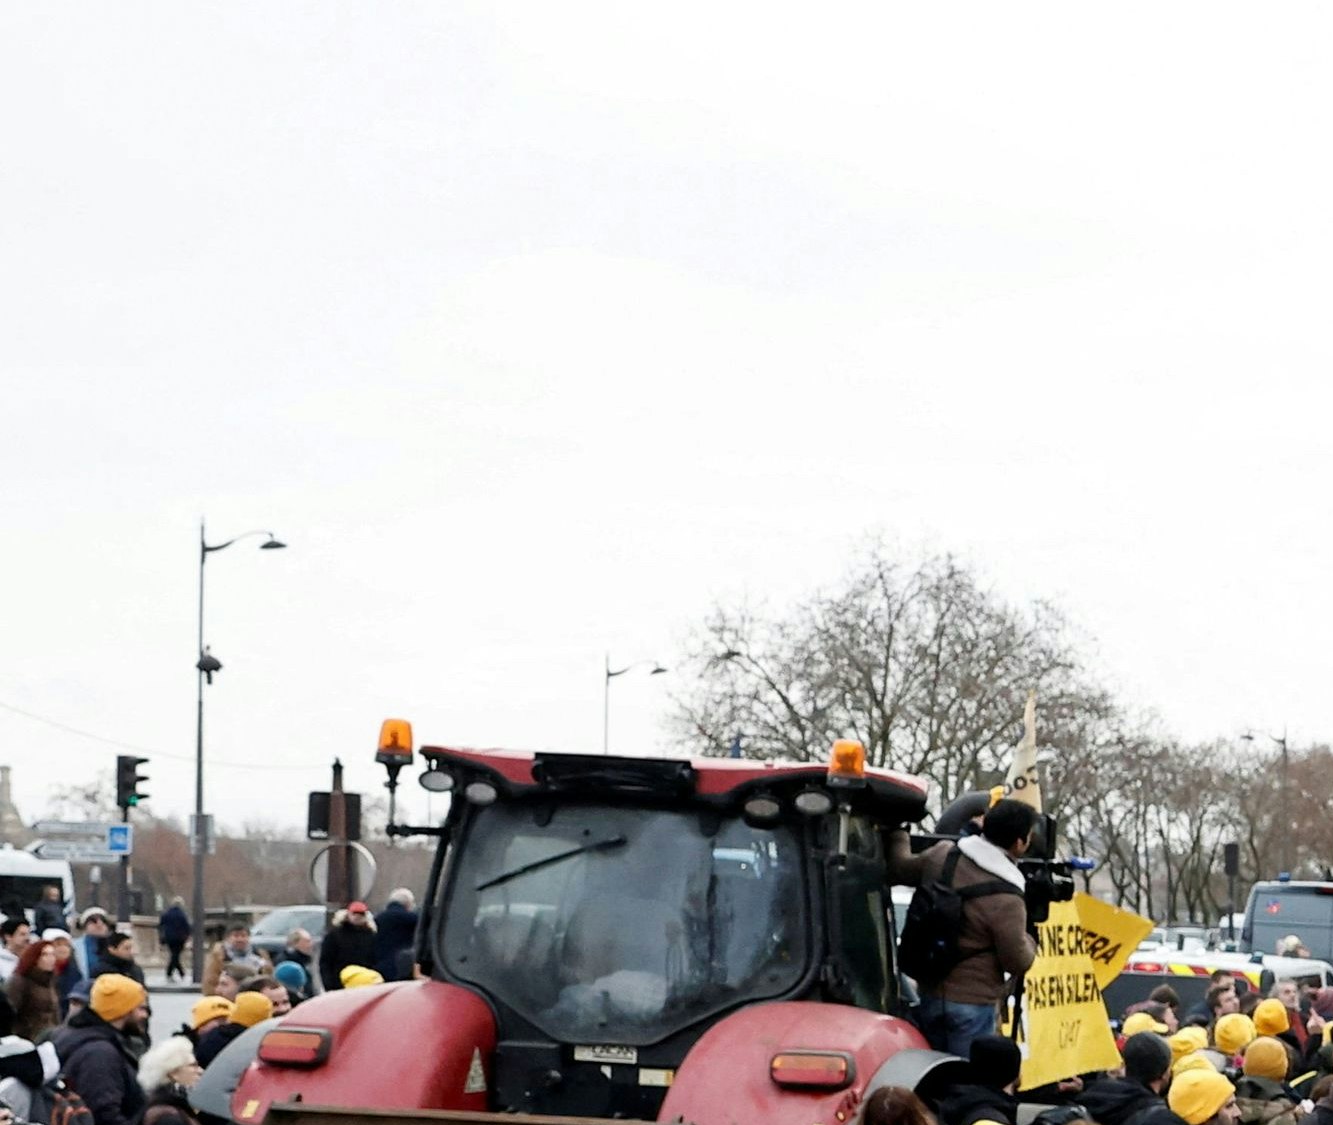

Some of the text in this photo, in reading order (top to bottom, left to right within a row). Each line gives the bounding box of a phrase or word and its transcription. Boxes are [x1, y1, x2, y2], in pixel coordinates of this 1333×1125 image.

[1047, 925, 1065, 957] NE
[1027, 977, 1047, 1010] PAS
[1049, 975, 1065, 1007] EN
